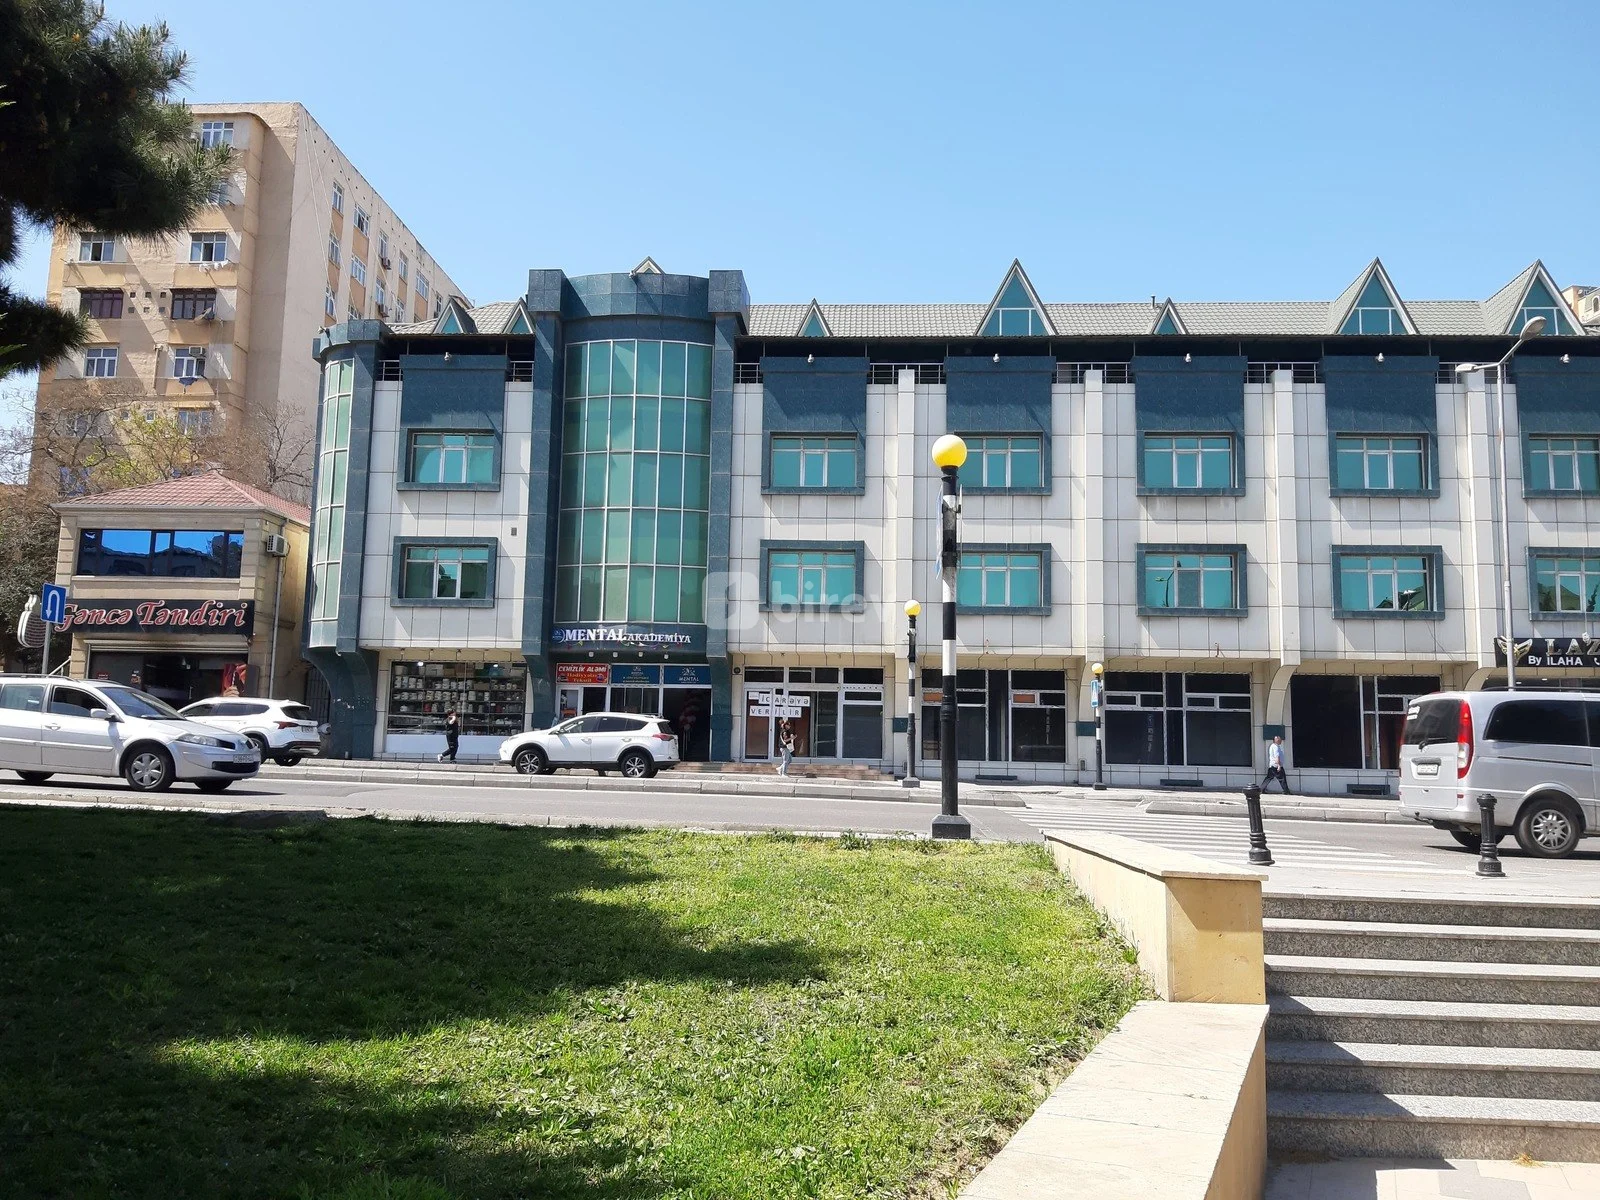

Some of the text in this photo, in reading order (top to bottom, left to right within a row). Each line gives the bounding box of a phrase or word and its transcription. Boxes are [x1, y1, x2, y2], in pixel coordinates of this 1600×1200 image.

[54, 600, 248, 632] Gəncə Təndiri
[565, 628, 627, 641] MENTAL
[628, 632, 692, 643] AKADEMİYA
[1528, 655, 1542, 666] By
[761, 695, 809, 705] İCARƏYƏ
[750, 708, 800, 716] VERİLİR
